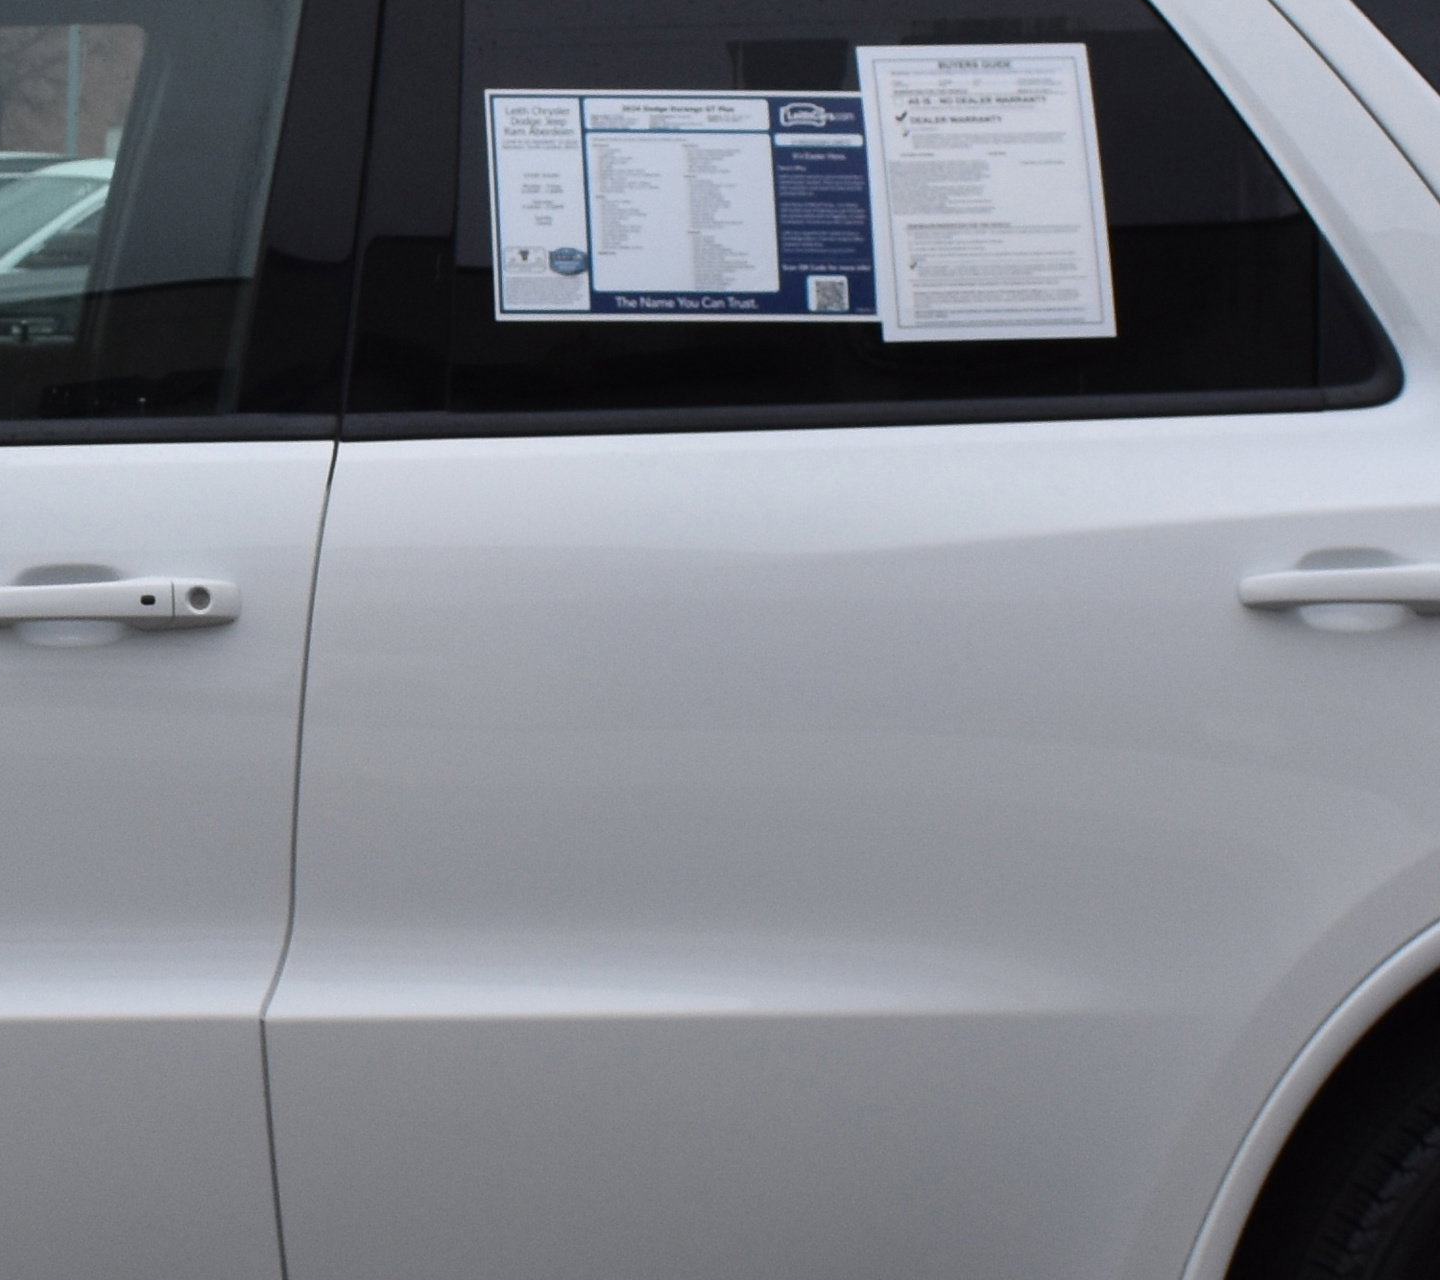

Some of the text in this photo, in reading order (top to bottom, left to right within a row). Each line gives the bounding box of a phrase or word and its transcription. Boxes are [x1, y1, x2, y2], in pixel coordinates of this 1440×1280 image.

[615, 296, 638, 309] The
[639, 296, 675, 309] Name
[677, 296, 700, 310] You
[700, 296, 726, 310] Can
